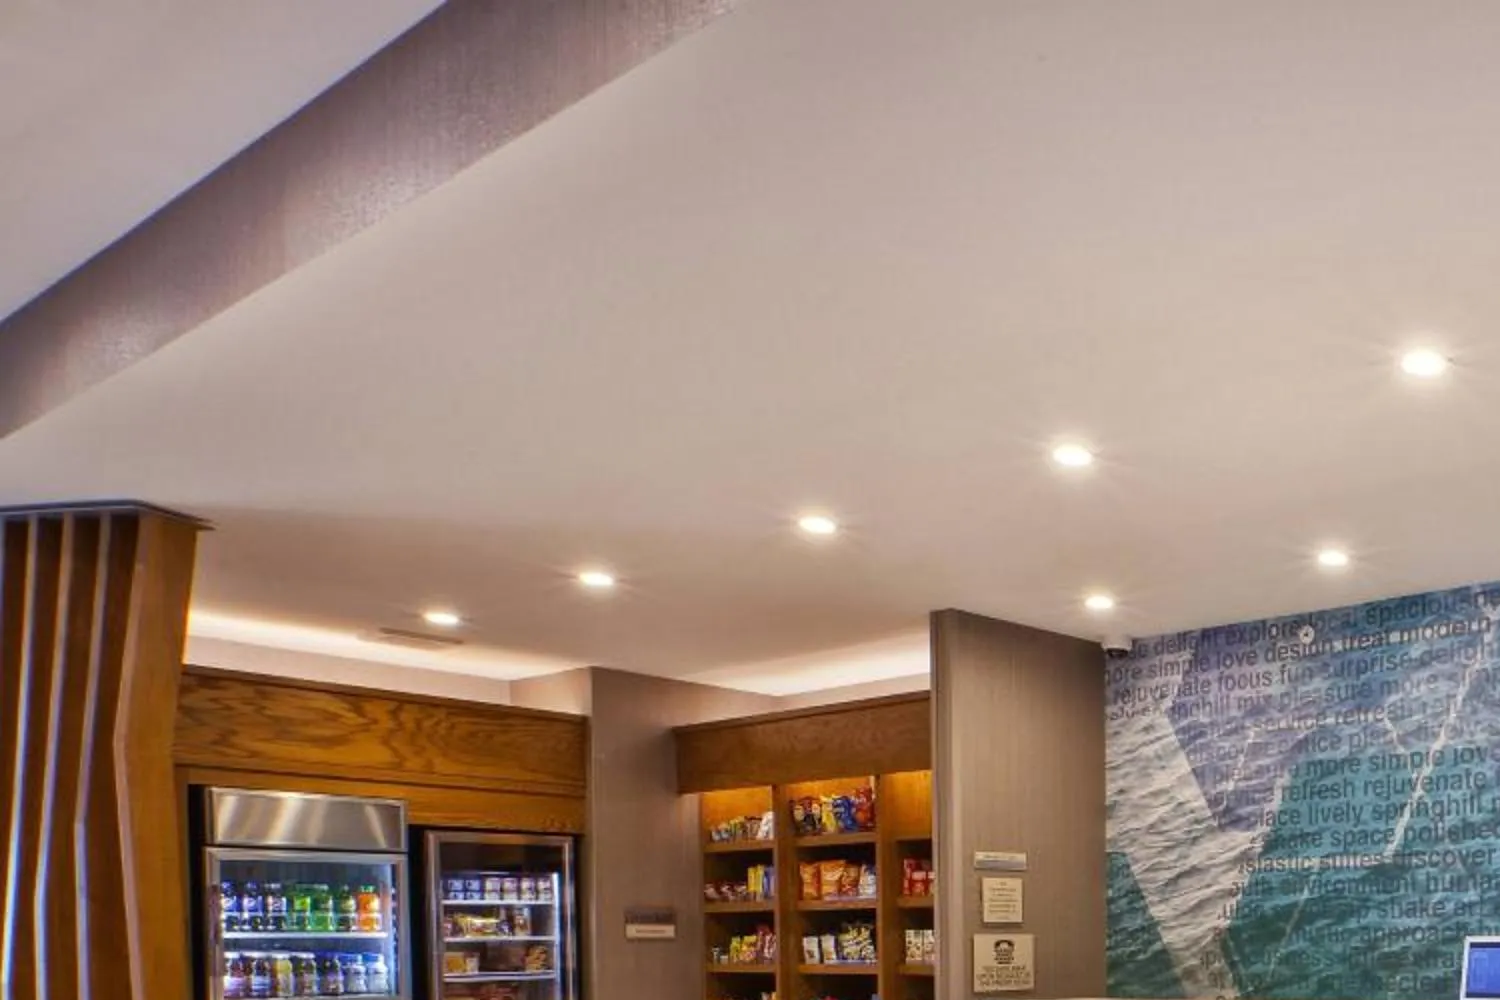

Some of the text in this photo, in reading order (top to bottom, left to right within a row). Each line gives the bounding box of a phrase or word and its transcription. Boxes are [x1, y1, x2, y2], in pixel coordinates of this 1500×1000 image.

[1148, 653, 1210, 679] simple
[1215, 649, 1257, 669] love
[1263, 637, 1334, 663] design
[1341, 626, 1392, 652] treat
[1399, 615, 1492, 644] modern
[1224, 619, 1300, 646] explore
[1217, 669, 1273, 691] focus
[1279, 662, 1313, 683] fun
[1320, 649, 1413, 679] surprise
[1306, 756, 1362, 776] more
[1368, 745, 1445, 773] simple
[1280, 775, 1356, 801] refresh
[1363, 768, 1487, 799] rejuvenate
[1307, 800, 1364, 826] lively
[1371, 791, 1483, 824] springhill
[1329, 827, 1396, 850] space
[1392, 846, 1496, 868] discover
